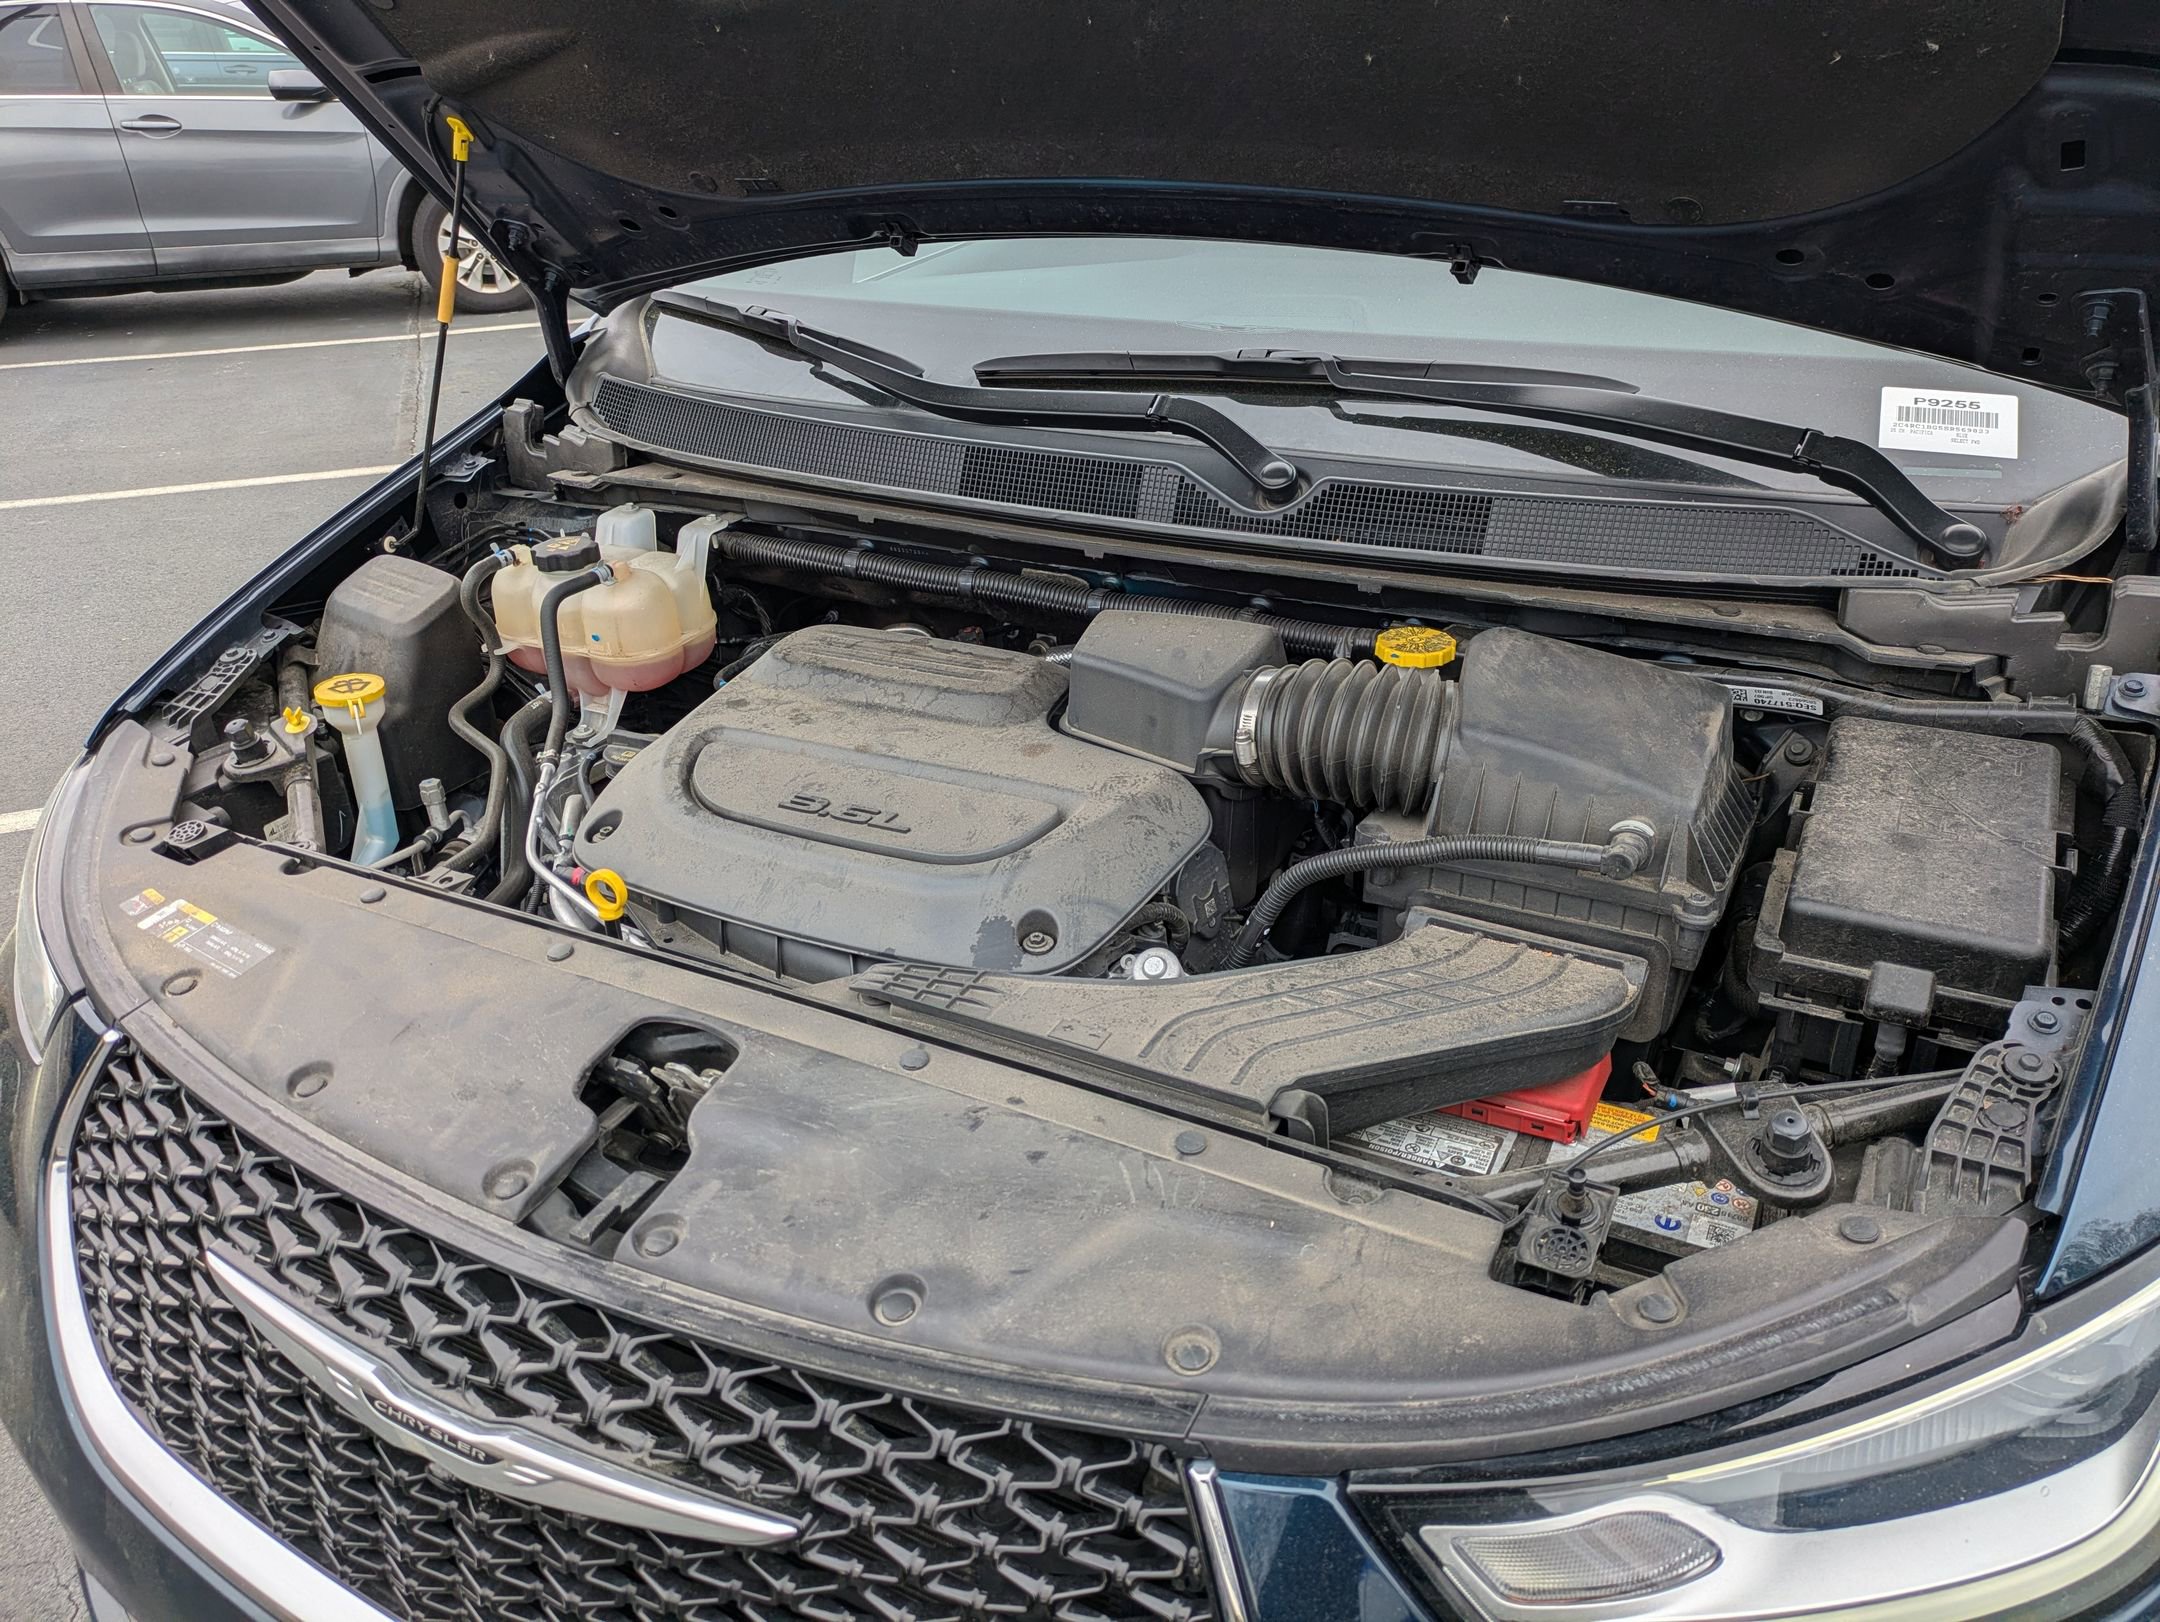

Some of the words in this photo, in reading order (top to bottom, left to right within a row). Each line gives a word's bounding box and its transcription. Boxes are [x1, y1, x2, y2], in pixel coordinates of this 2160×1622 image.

[1914, 397, 1981, 409] P9255
[1754, 698, 1816, 710] SEQ:517740
[778, 793, 911, 834] 3.6L
[1368, 1144, 1434, 1165] DANGER/POISON
[1696, 1204, 1720, 1215] 230
[374, 1400, 486, 1461] CHRYSLER
